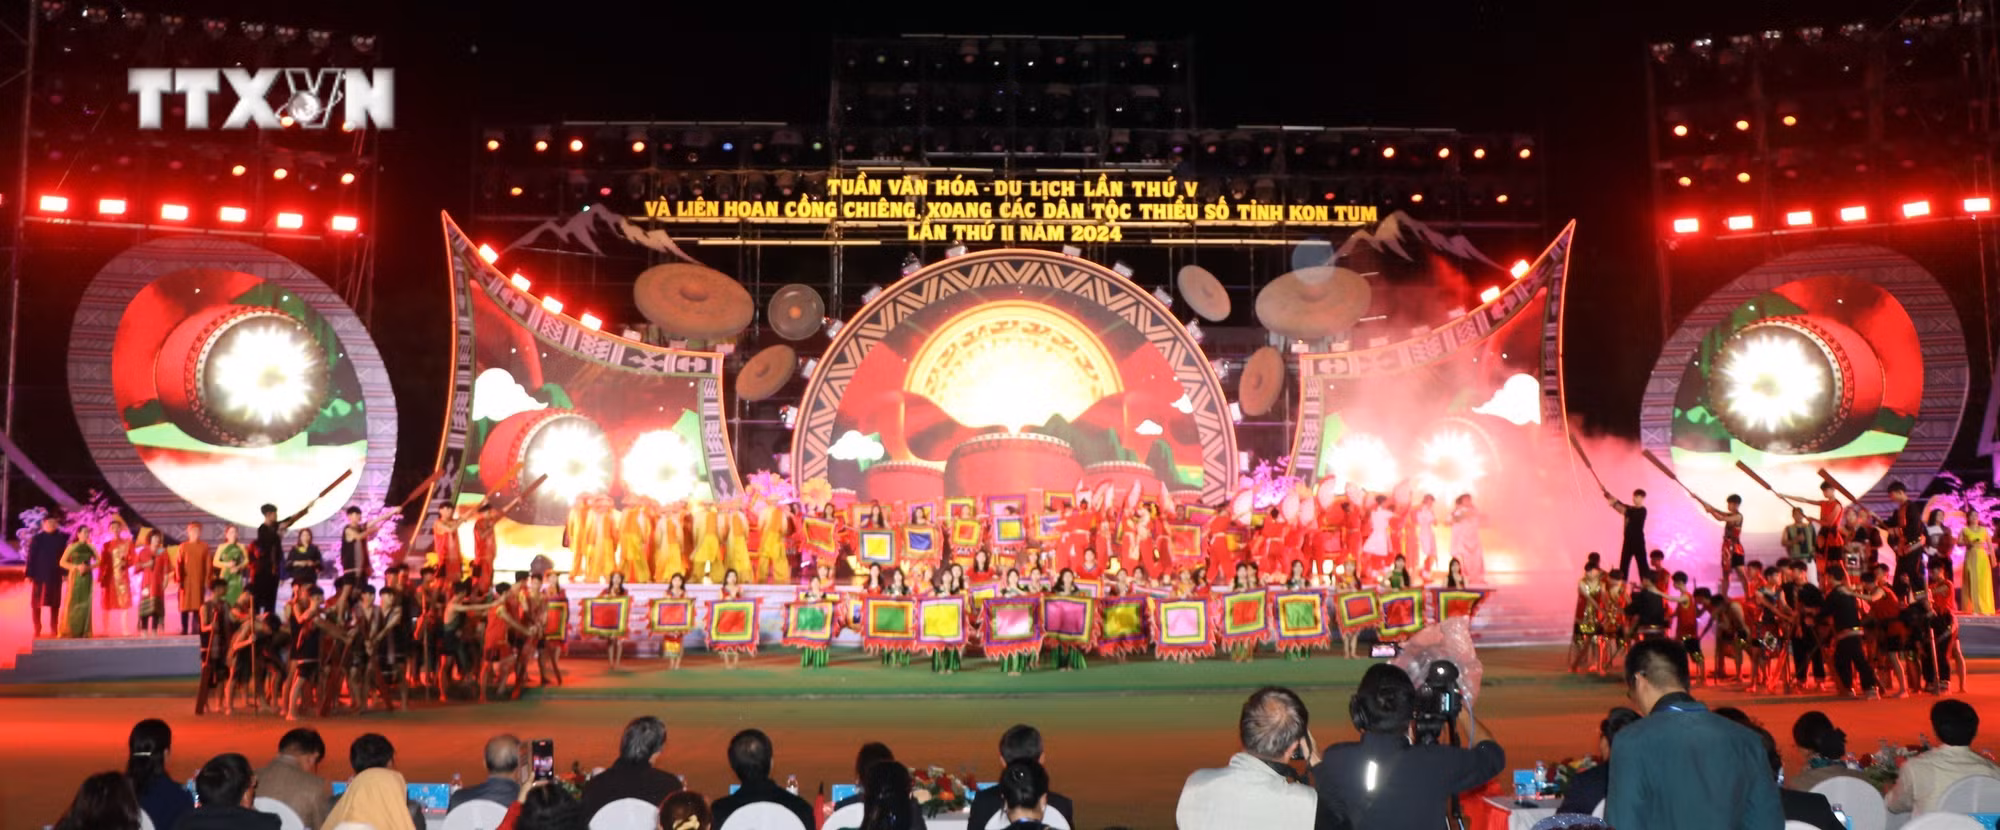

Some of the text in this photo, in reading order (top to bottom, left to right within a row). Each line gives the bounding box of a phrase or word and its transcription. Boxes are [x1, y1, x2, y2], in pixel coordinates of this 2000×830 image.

[827, 171, 882, 196] TUẦN
[887, 175, 928, 196] VĂN
[935, 174, 979, 196] HÓA
[994, 180, 1022, 197] DU
[1030, 180, 1075, 201] LỊCH
[1083, 173, 1123, 198] LẦN
[1131, 175, 1177, 198] THỨ
[1184, 181, 1198, 197] V
[645, 195, 671, 217] VÀ
[677, 195, 719, 217] LIÊN
[724, 201, 779, 217] HOAN
[927, 202, 992, 219] XOANG
[1000, 197, 1036, 219] CÁC
[1043, 198, 1084, 219] DÂN
[1092, 198, 1131, 224] TỘC
[1139, 194, 1198, 221] THIỂU
[1204, 195, 1230, 221] SỐ
[1237, 199, 1283, 221] TỈNH
[1289, 205, 1328, 222] KON
[1334, 205, 1378, 222] TUM
[907, 217, 1122, 242] LẦN THỨ II NĂM 2024
